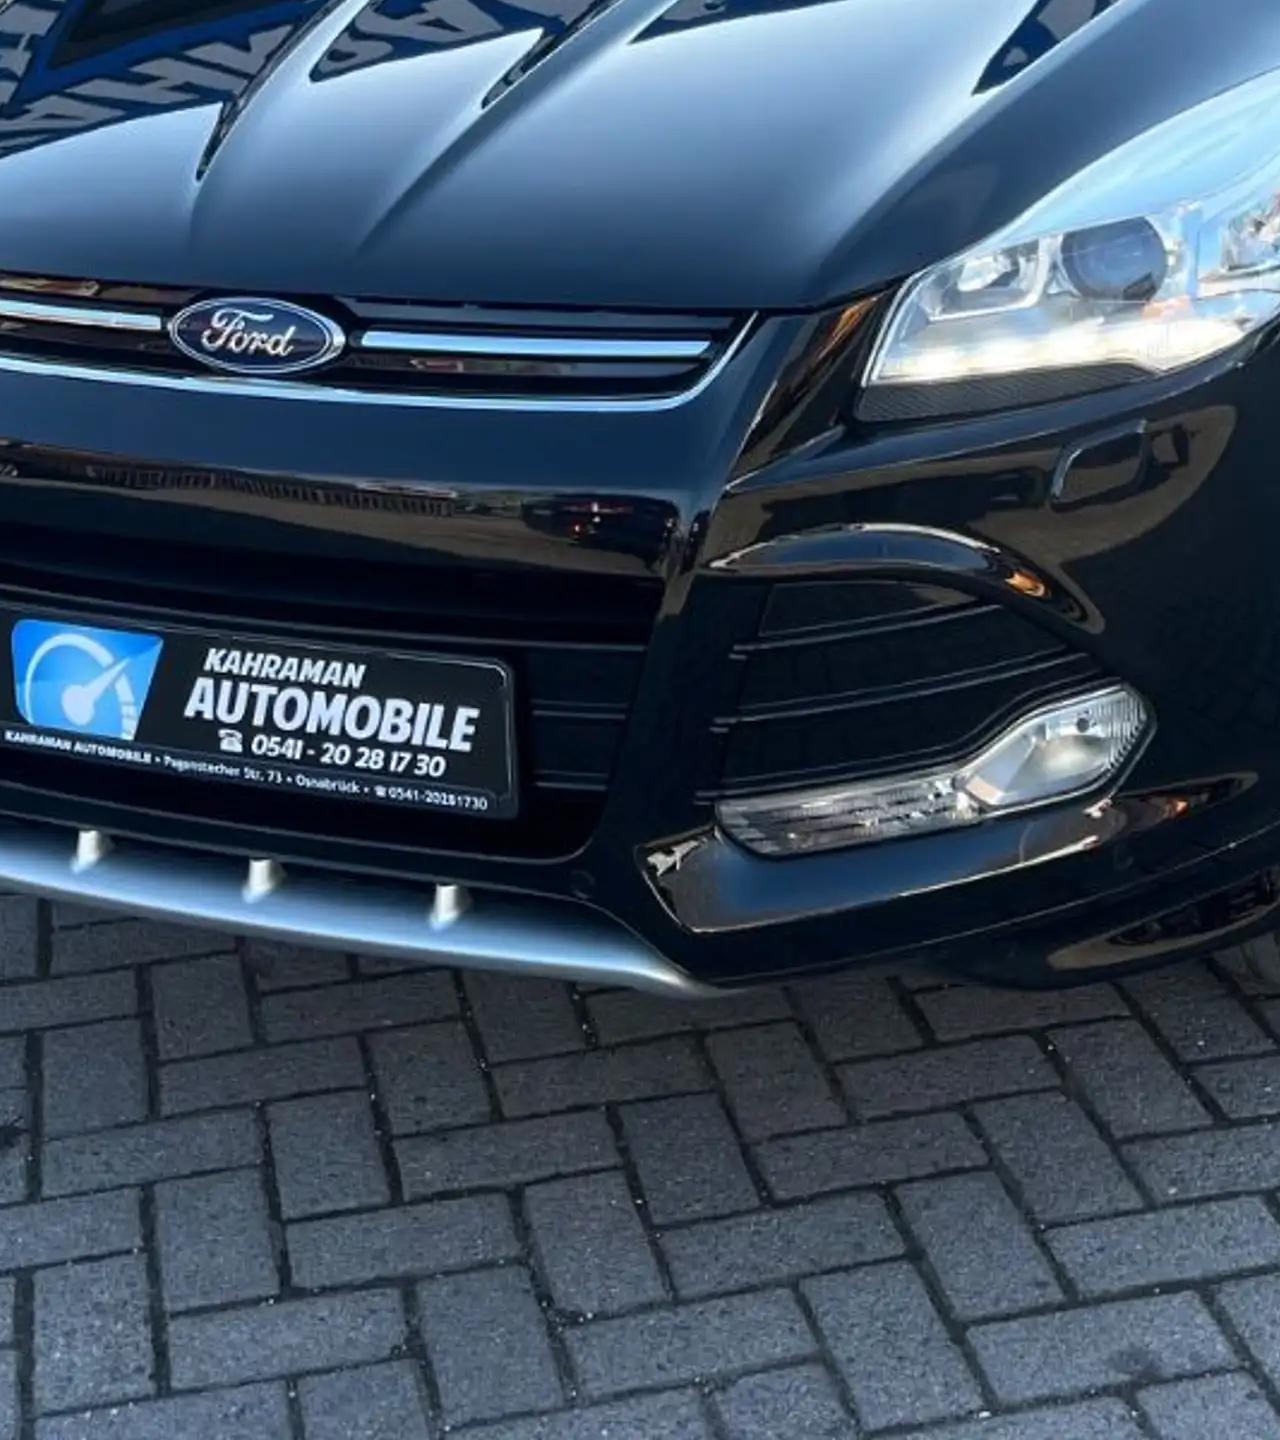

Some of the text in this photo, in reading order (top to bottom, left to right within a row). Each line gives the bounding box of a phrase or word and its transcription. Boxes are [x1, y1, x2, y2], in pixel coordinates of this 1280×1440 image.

[200, 307, 297, 358] Ford
[203, 647, 367, 689] KAHRAMAN
[183, 676, 481, 753] AUTOMOBILE
[4, 729, 72, 751] KAHRAMAN
[73, 742, 153, 764] AUTOMOBILE
[295, 773, 361, 795] Osnabrück
[251, 733, 304, 760] 0541
[319, 742, 351, 765] 20
[354, 746, 385, 770] 28
[389, 750, 414, 773] 17
[414, 754, 447, 778] 30
